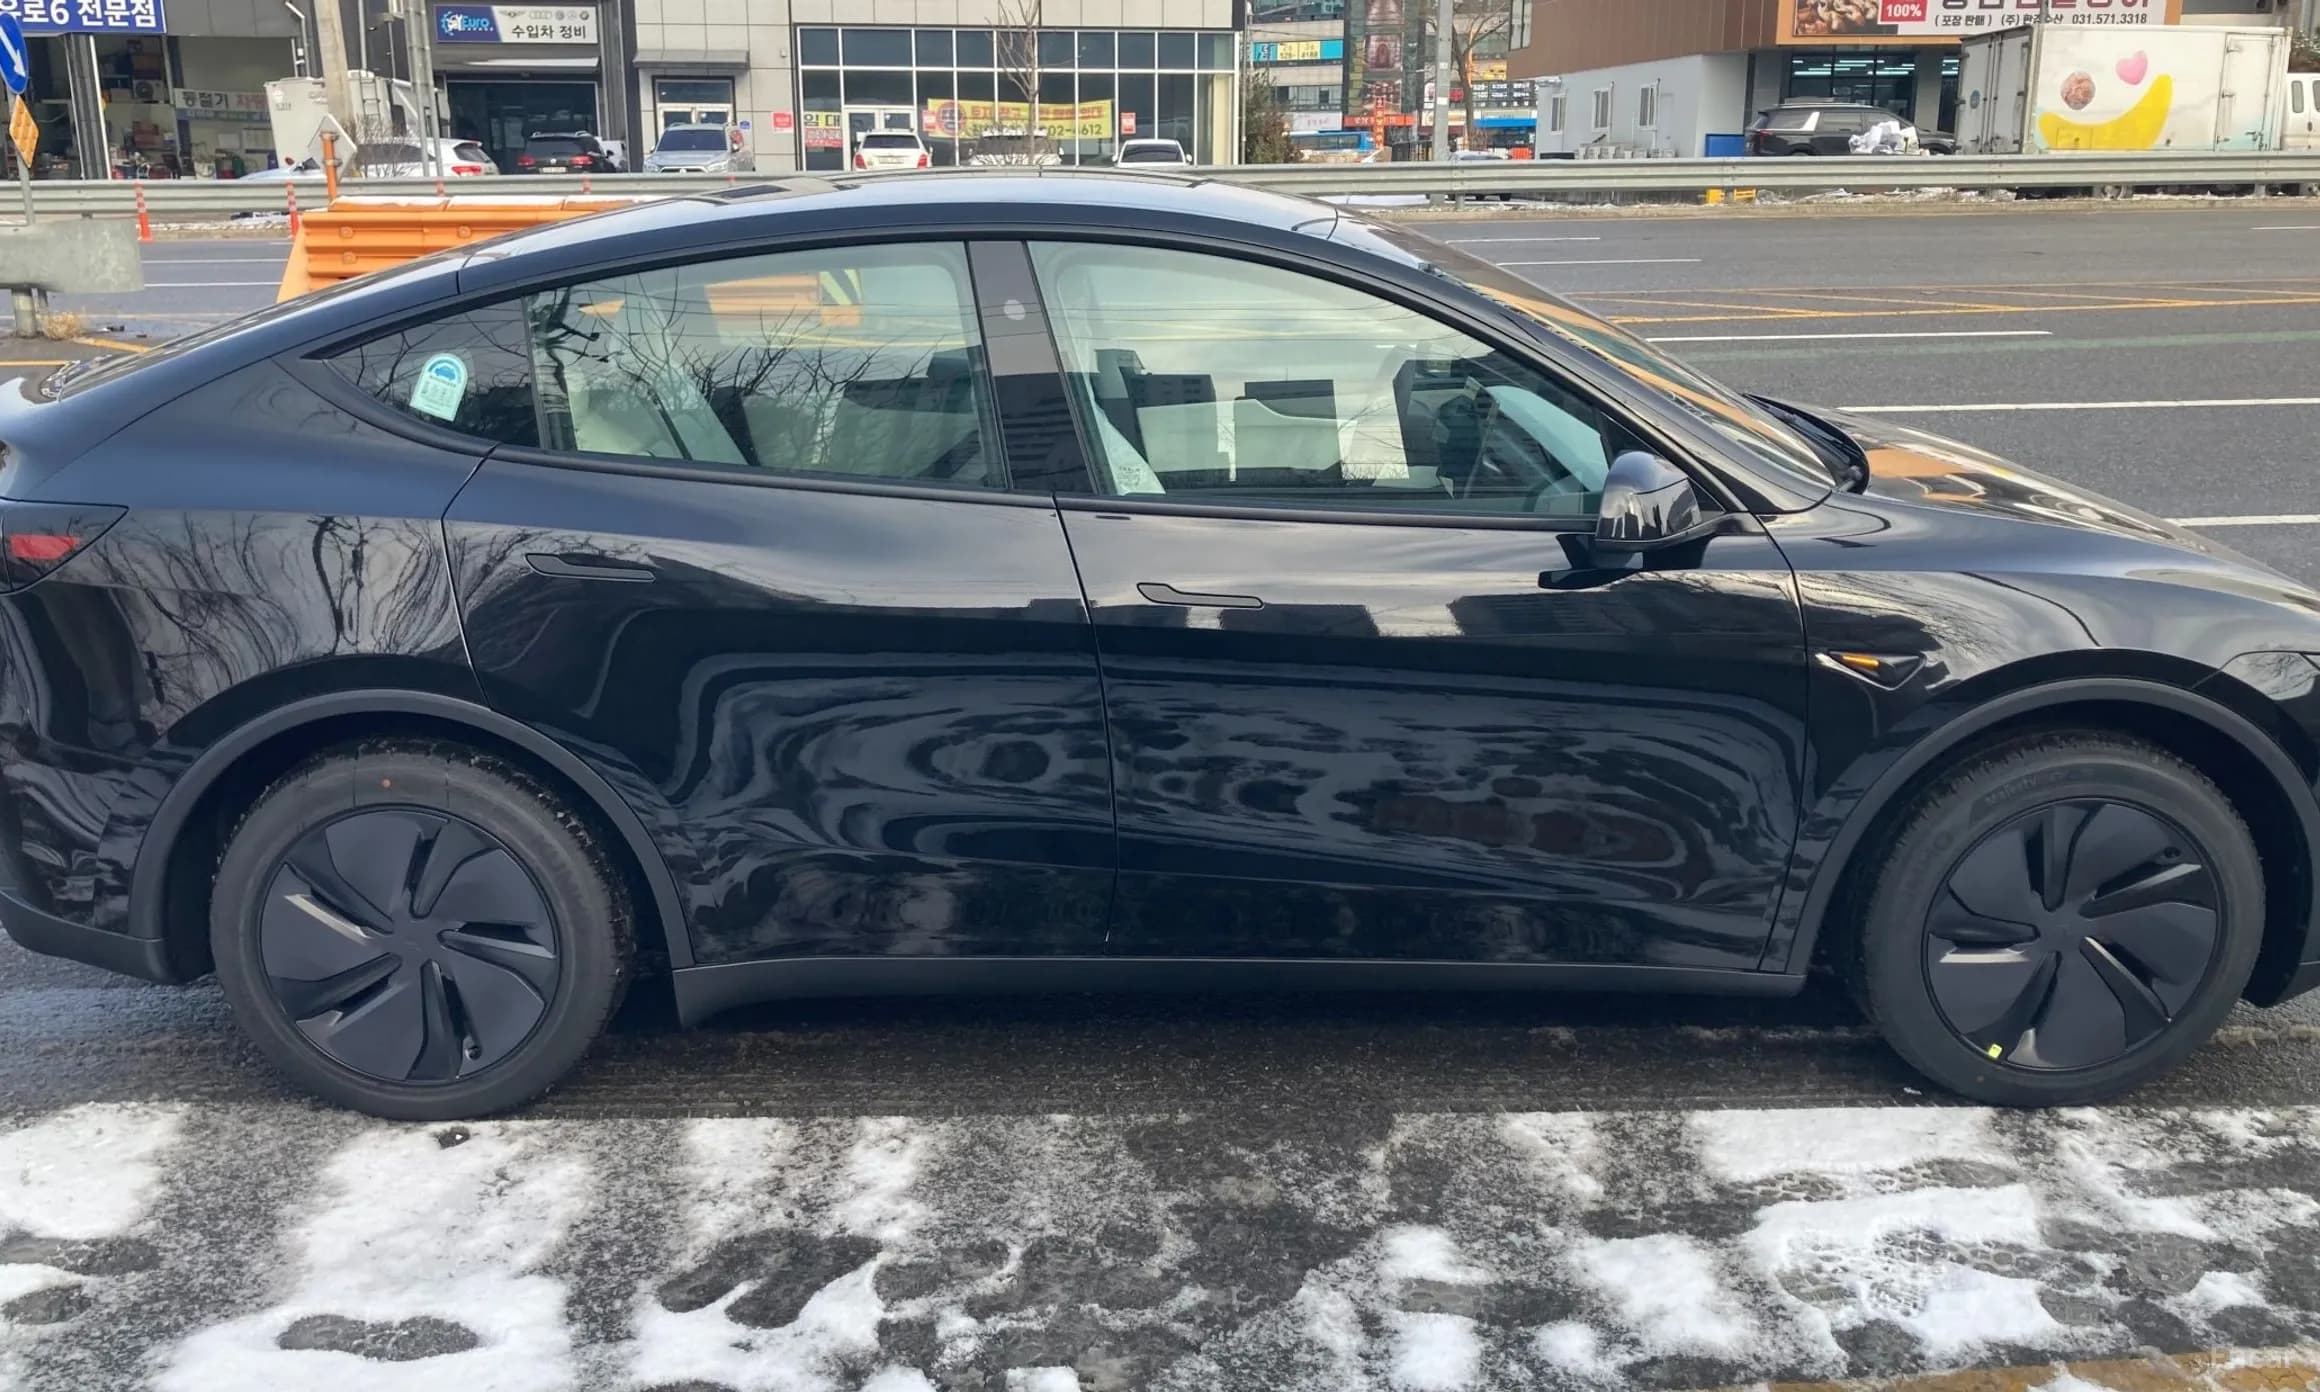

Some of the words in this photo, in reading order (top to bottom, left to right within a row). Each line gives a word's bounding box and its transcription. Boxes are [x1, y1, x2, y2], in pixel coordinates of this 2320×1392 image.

[77, 0, 157, 28] 전문점
[1886, 4, 1922, 17] 100%
[2072, 13, 2147, 25] 031.571.3318
[512, 25, 554, 39] 수입차
[560, 25, 586, 39] 정비
